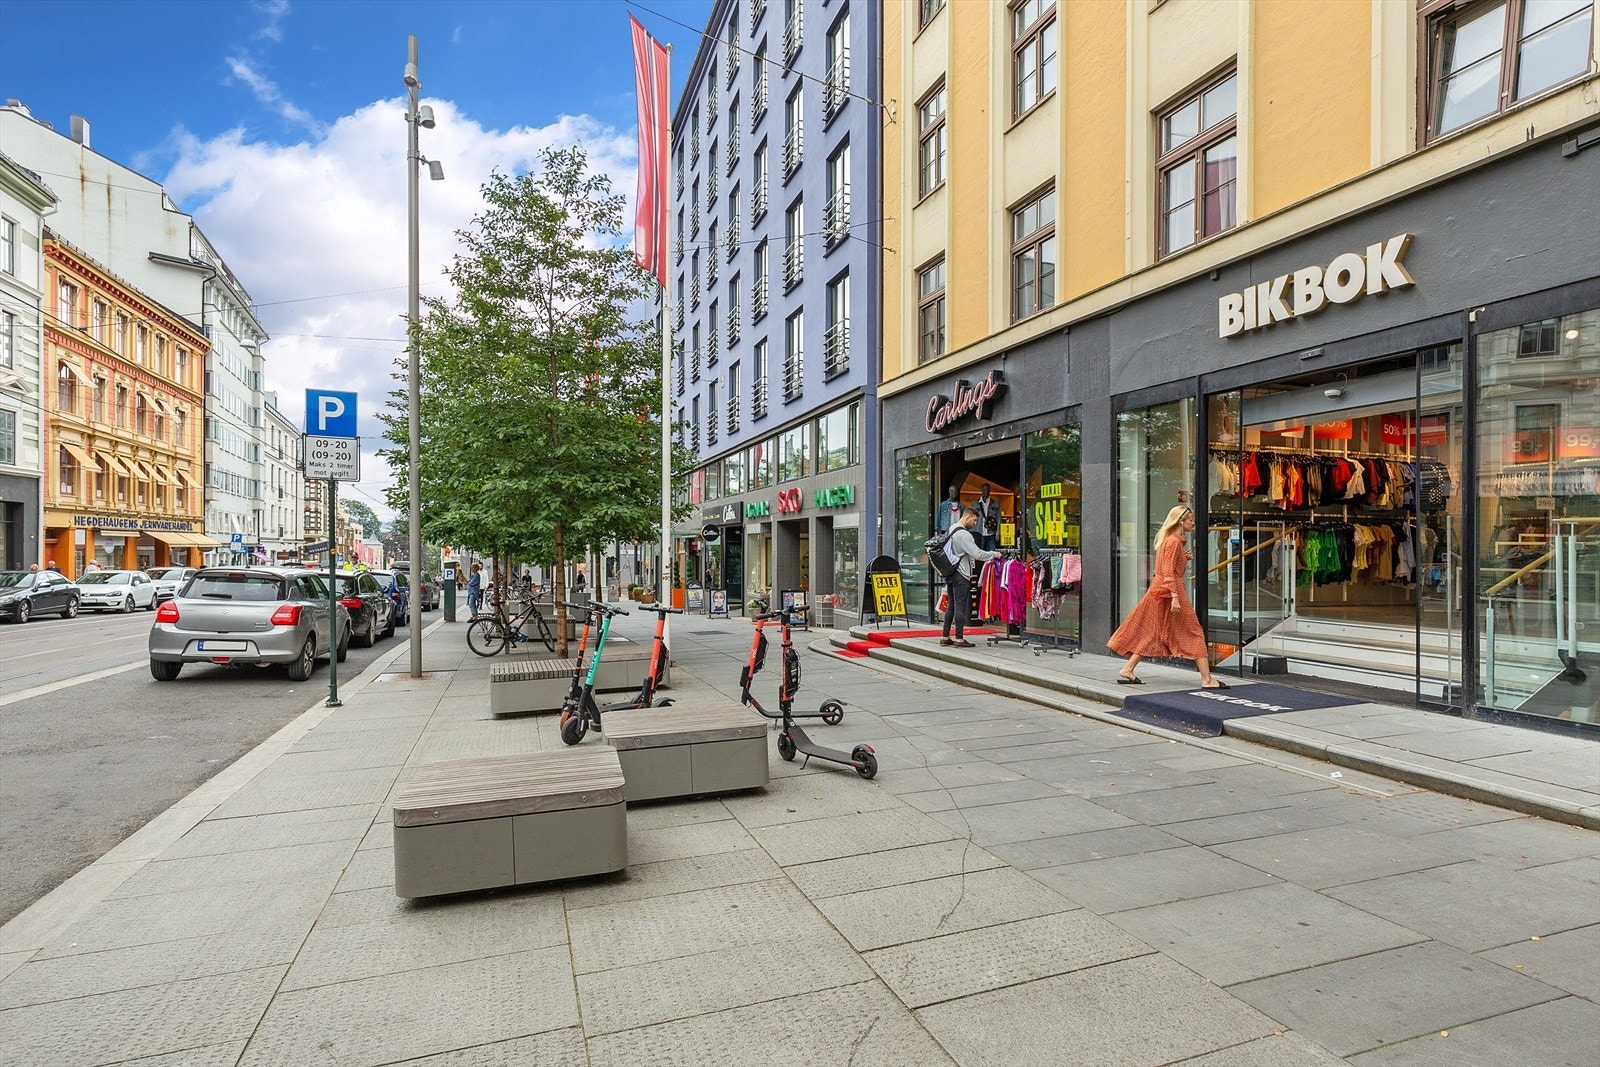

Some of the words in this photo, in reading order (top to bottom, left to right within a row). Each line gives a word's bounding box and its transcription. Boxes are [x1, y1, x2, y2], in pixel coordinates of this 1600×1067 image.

[925, 371, 998, 433] Carlings
[318, 395, 345, 431] P
[1383, 423, 1401, 437] 50%
[777, 487, 803, 513] SKO
[815, 484, 855, 509] HAGEN
[74, 515, 139, 529] HEGDEHAUGENS
[140, 519, 194, 532] JERNVAREHANDEL
[1035, 499, 1068, 540] SALE
[234, 534, 240, 542] P
[876, 577, 898, 588] SALE
[879, 594, 903, 613] 50%
